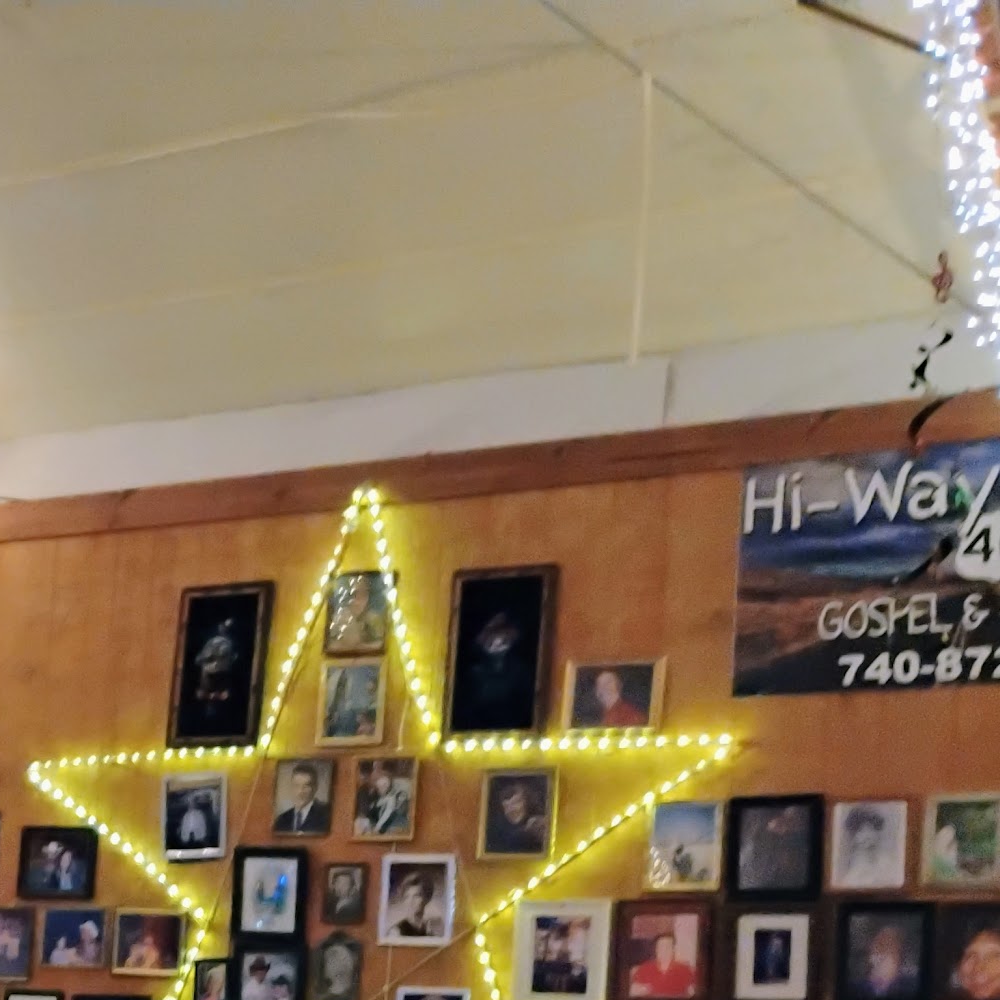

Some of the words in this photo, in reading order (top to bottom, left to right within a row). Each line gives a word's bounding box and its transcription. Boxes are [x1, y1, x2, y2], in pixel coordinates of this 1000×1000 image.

[743, 461, 1000, 536] Hi-Way
[817, 593, 953, 641] GOSPEL
[963, 593, 989, 630] &
